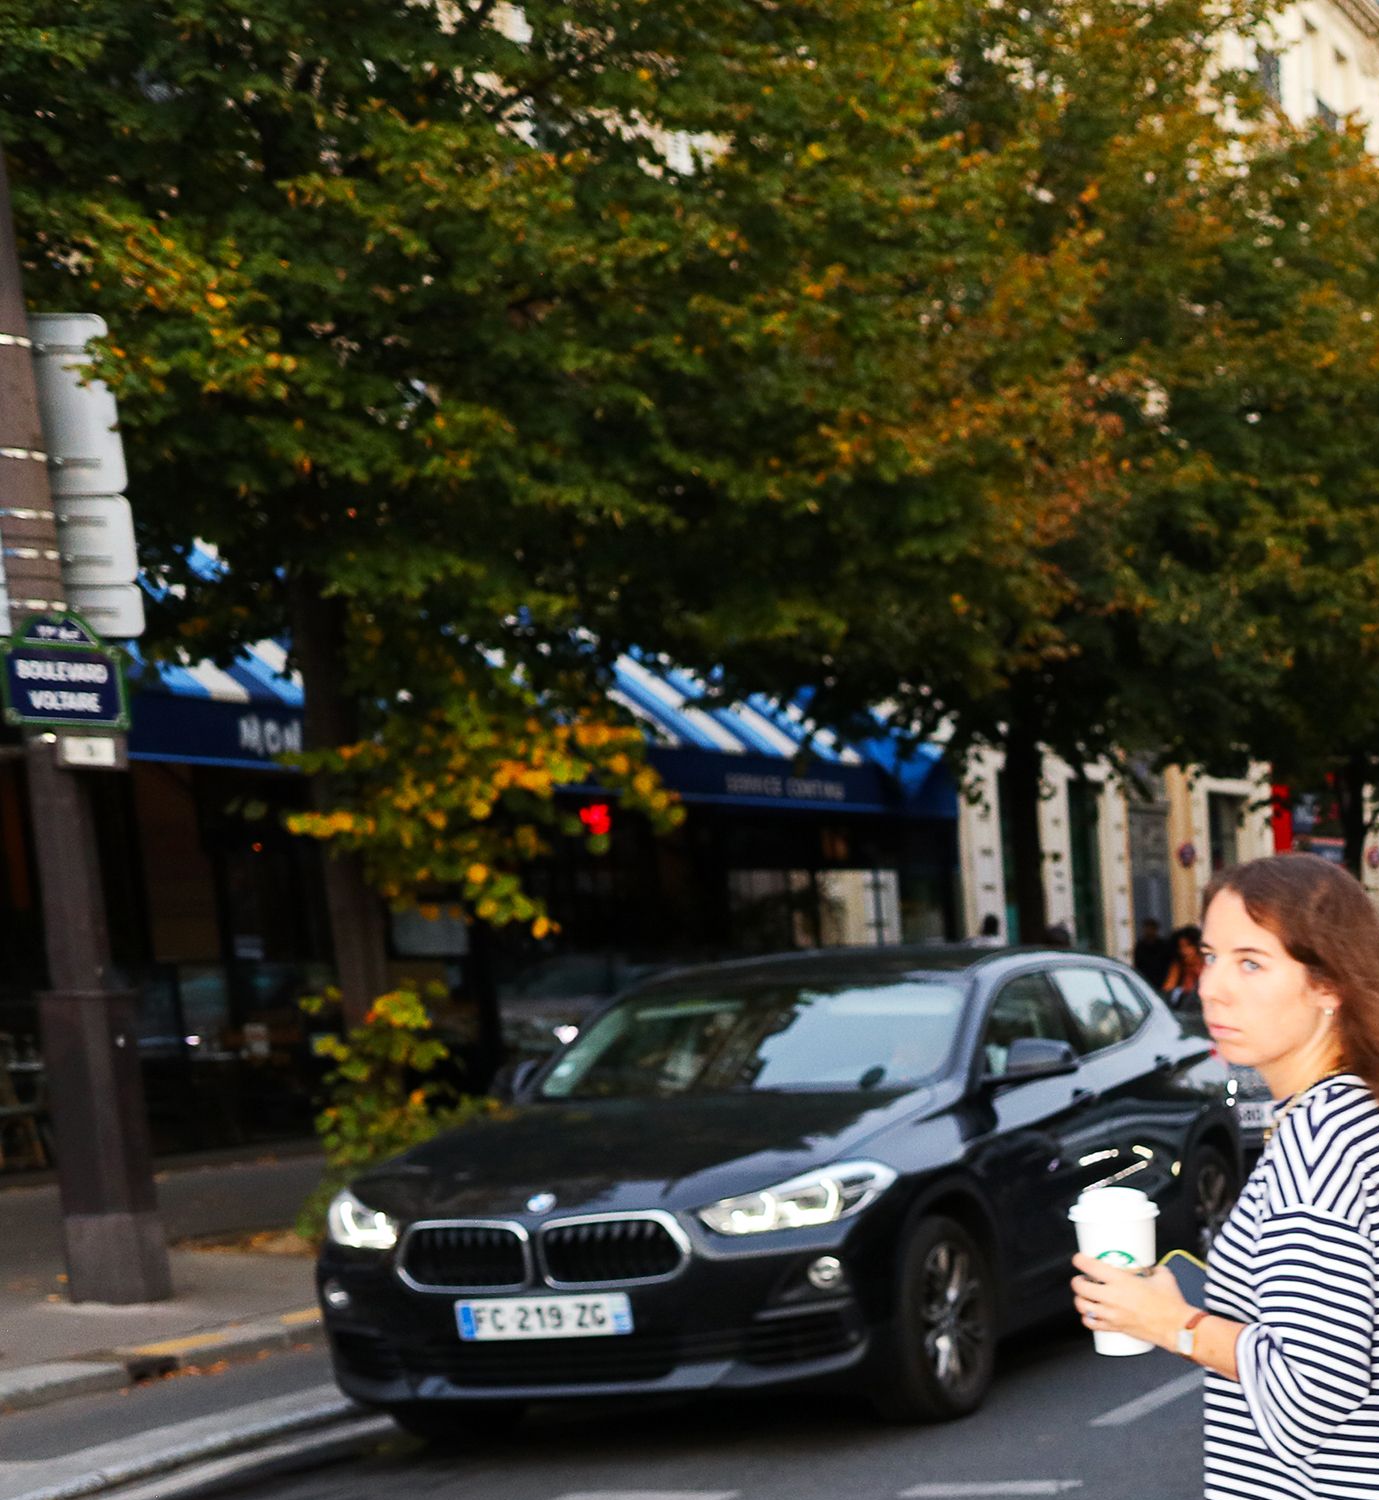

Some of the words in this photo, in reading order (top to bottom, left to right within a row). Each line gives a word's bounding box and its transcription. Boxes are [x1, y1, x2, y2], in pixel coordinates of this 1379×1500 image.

[15, 658, 109, 684] BOULEVARD
[27, 689, 102, 713] VOLTAIRE
[516, 1305, 565, 1331] 219
